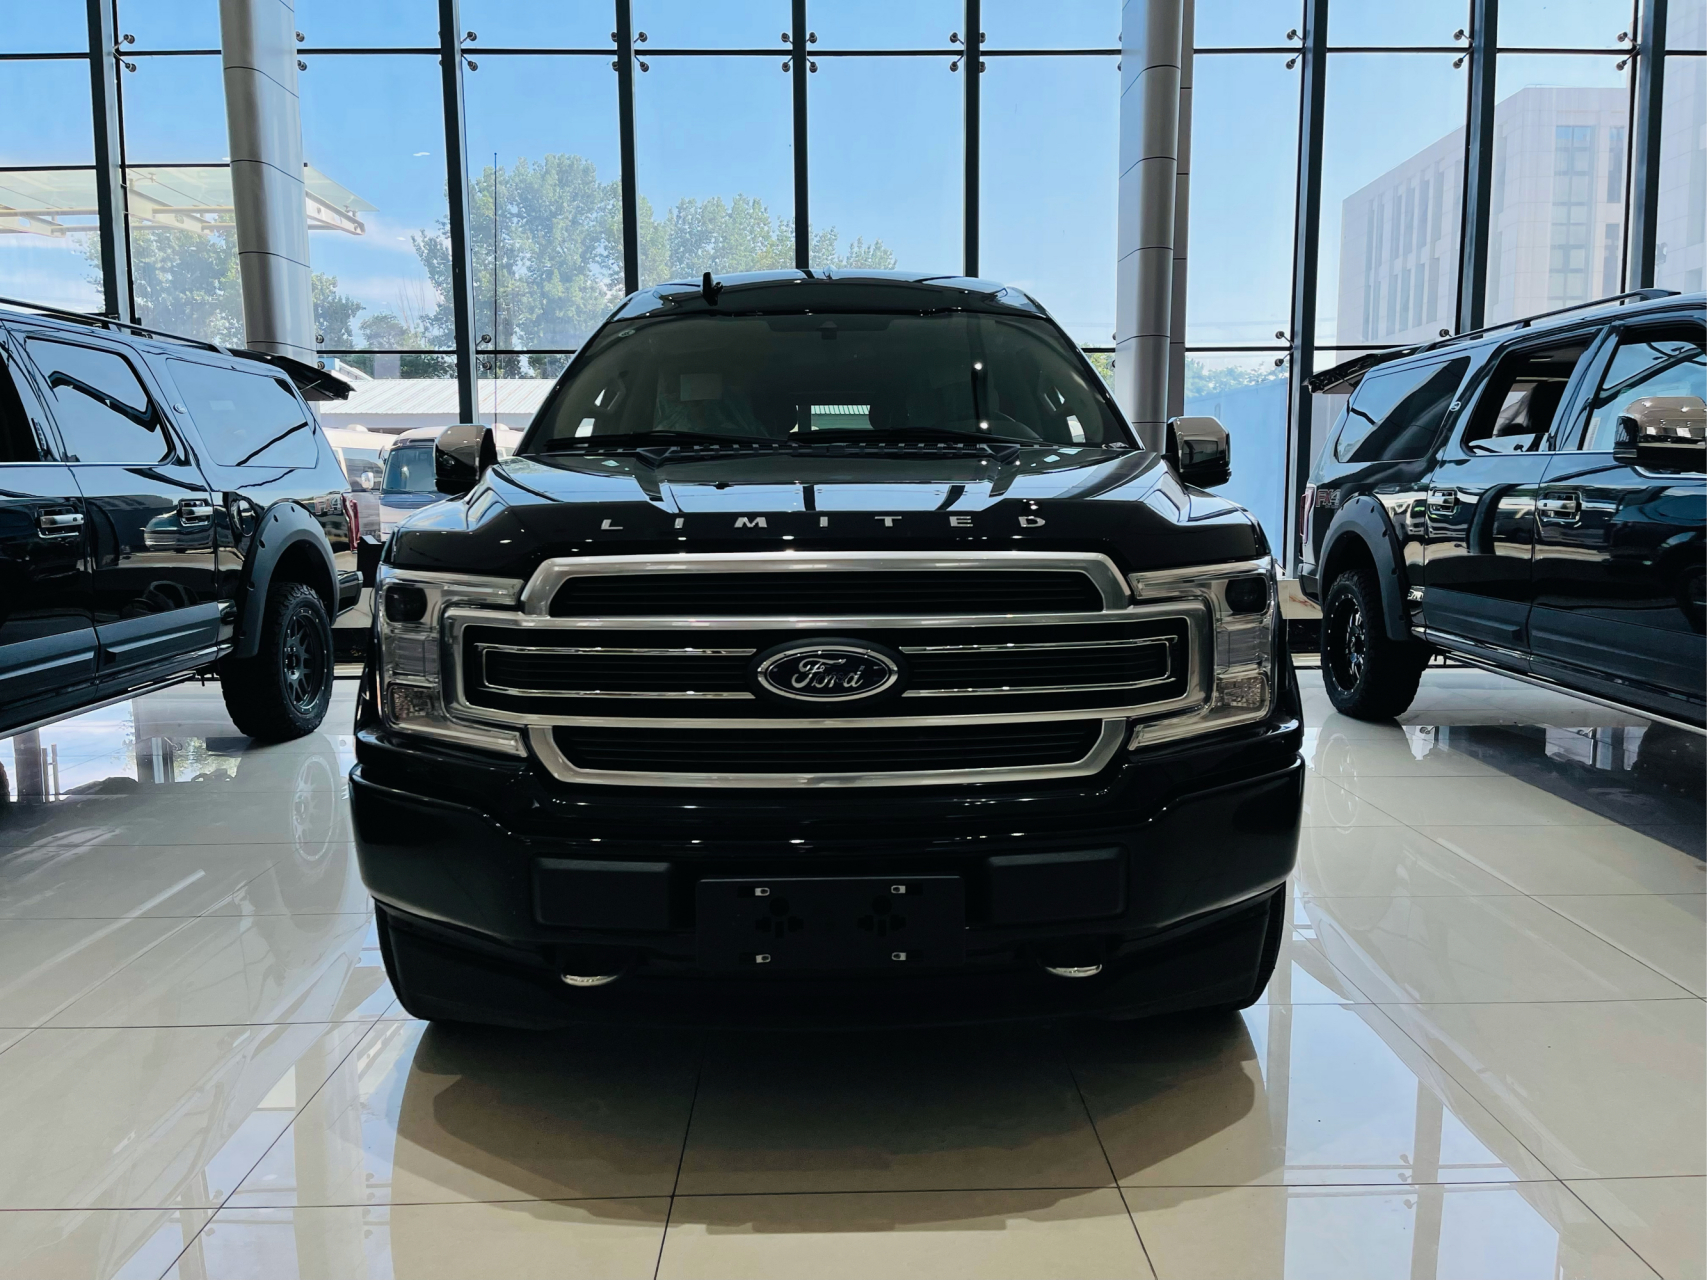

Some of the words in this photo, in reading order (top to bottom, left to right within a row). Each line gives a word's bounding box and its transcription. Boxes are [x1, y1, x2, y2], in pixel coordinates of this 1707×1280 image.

[1316, 489, 1341, 507] FX4
[601, 516, 1046, 530] LIMITED
[791, 658, 863, 688] Ford
